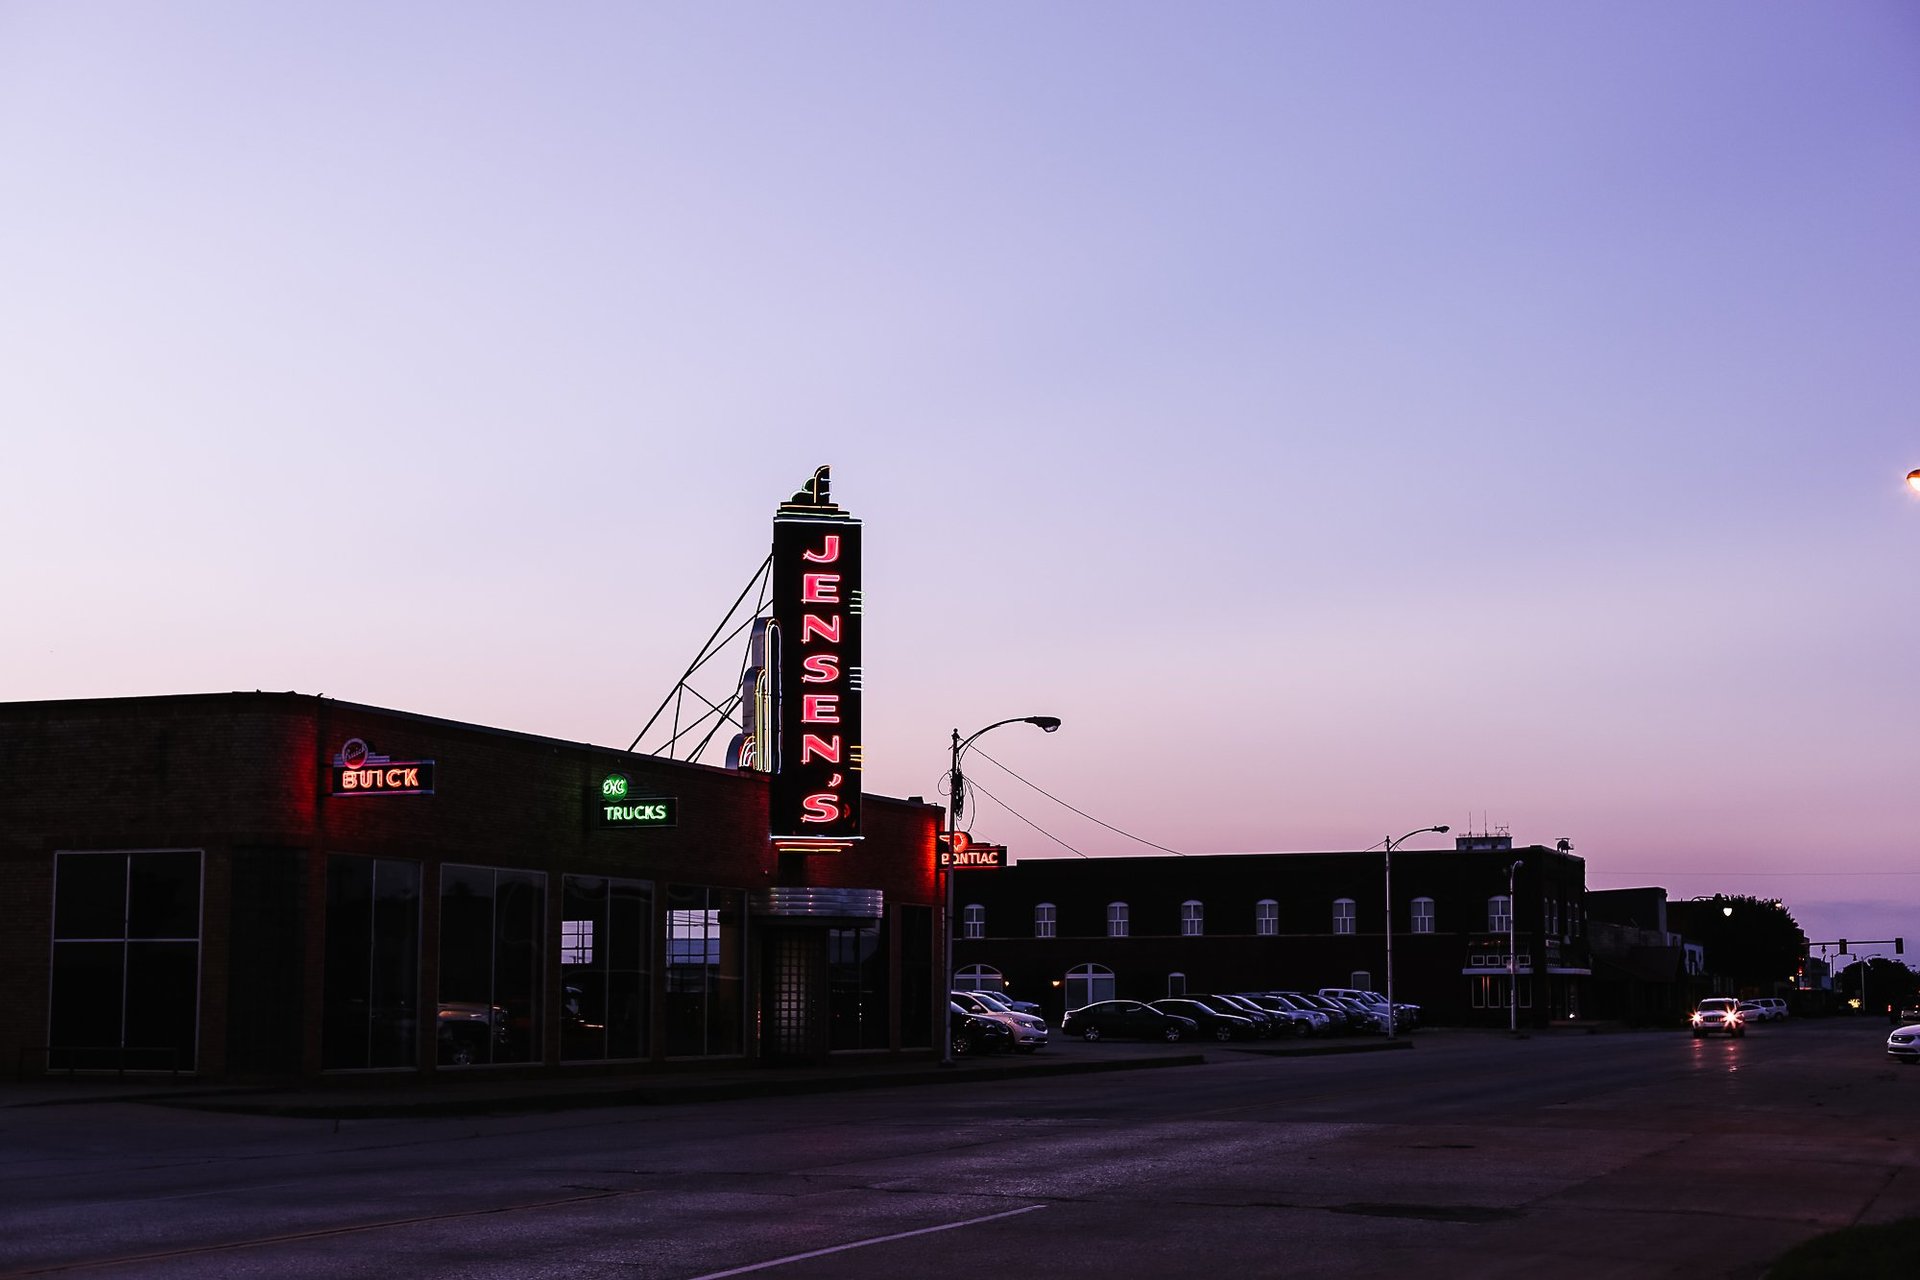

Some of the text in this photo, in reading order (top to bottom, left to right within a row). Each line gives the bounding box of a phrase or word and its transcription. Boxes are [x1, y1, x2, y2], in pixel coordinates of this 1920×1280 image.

[801, 536, 842, 822] JENSEN'S
[342, 768, 419, 789] BUICK
[603, 805, 667, 821] TRUCKS
